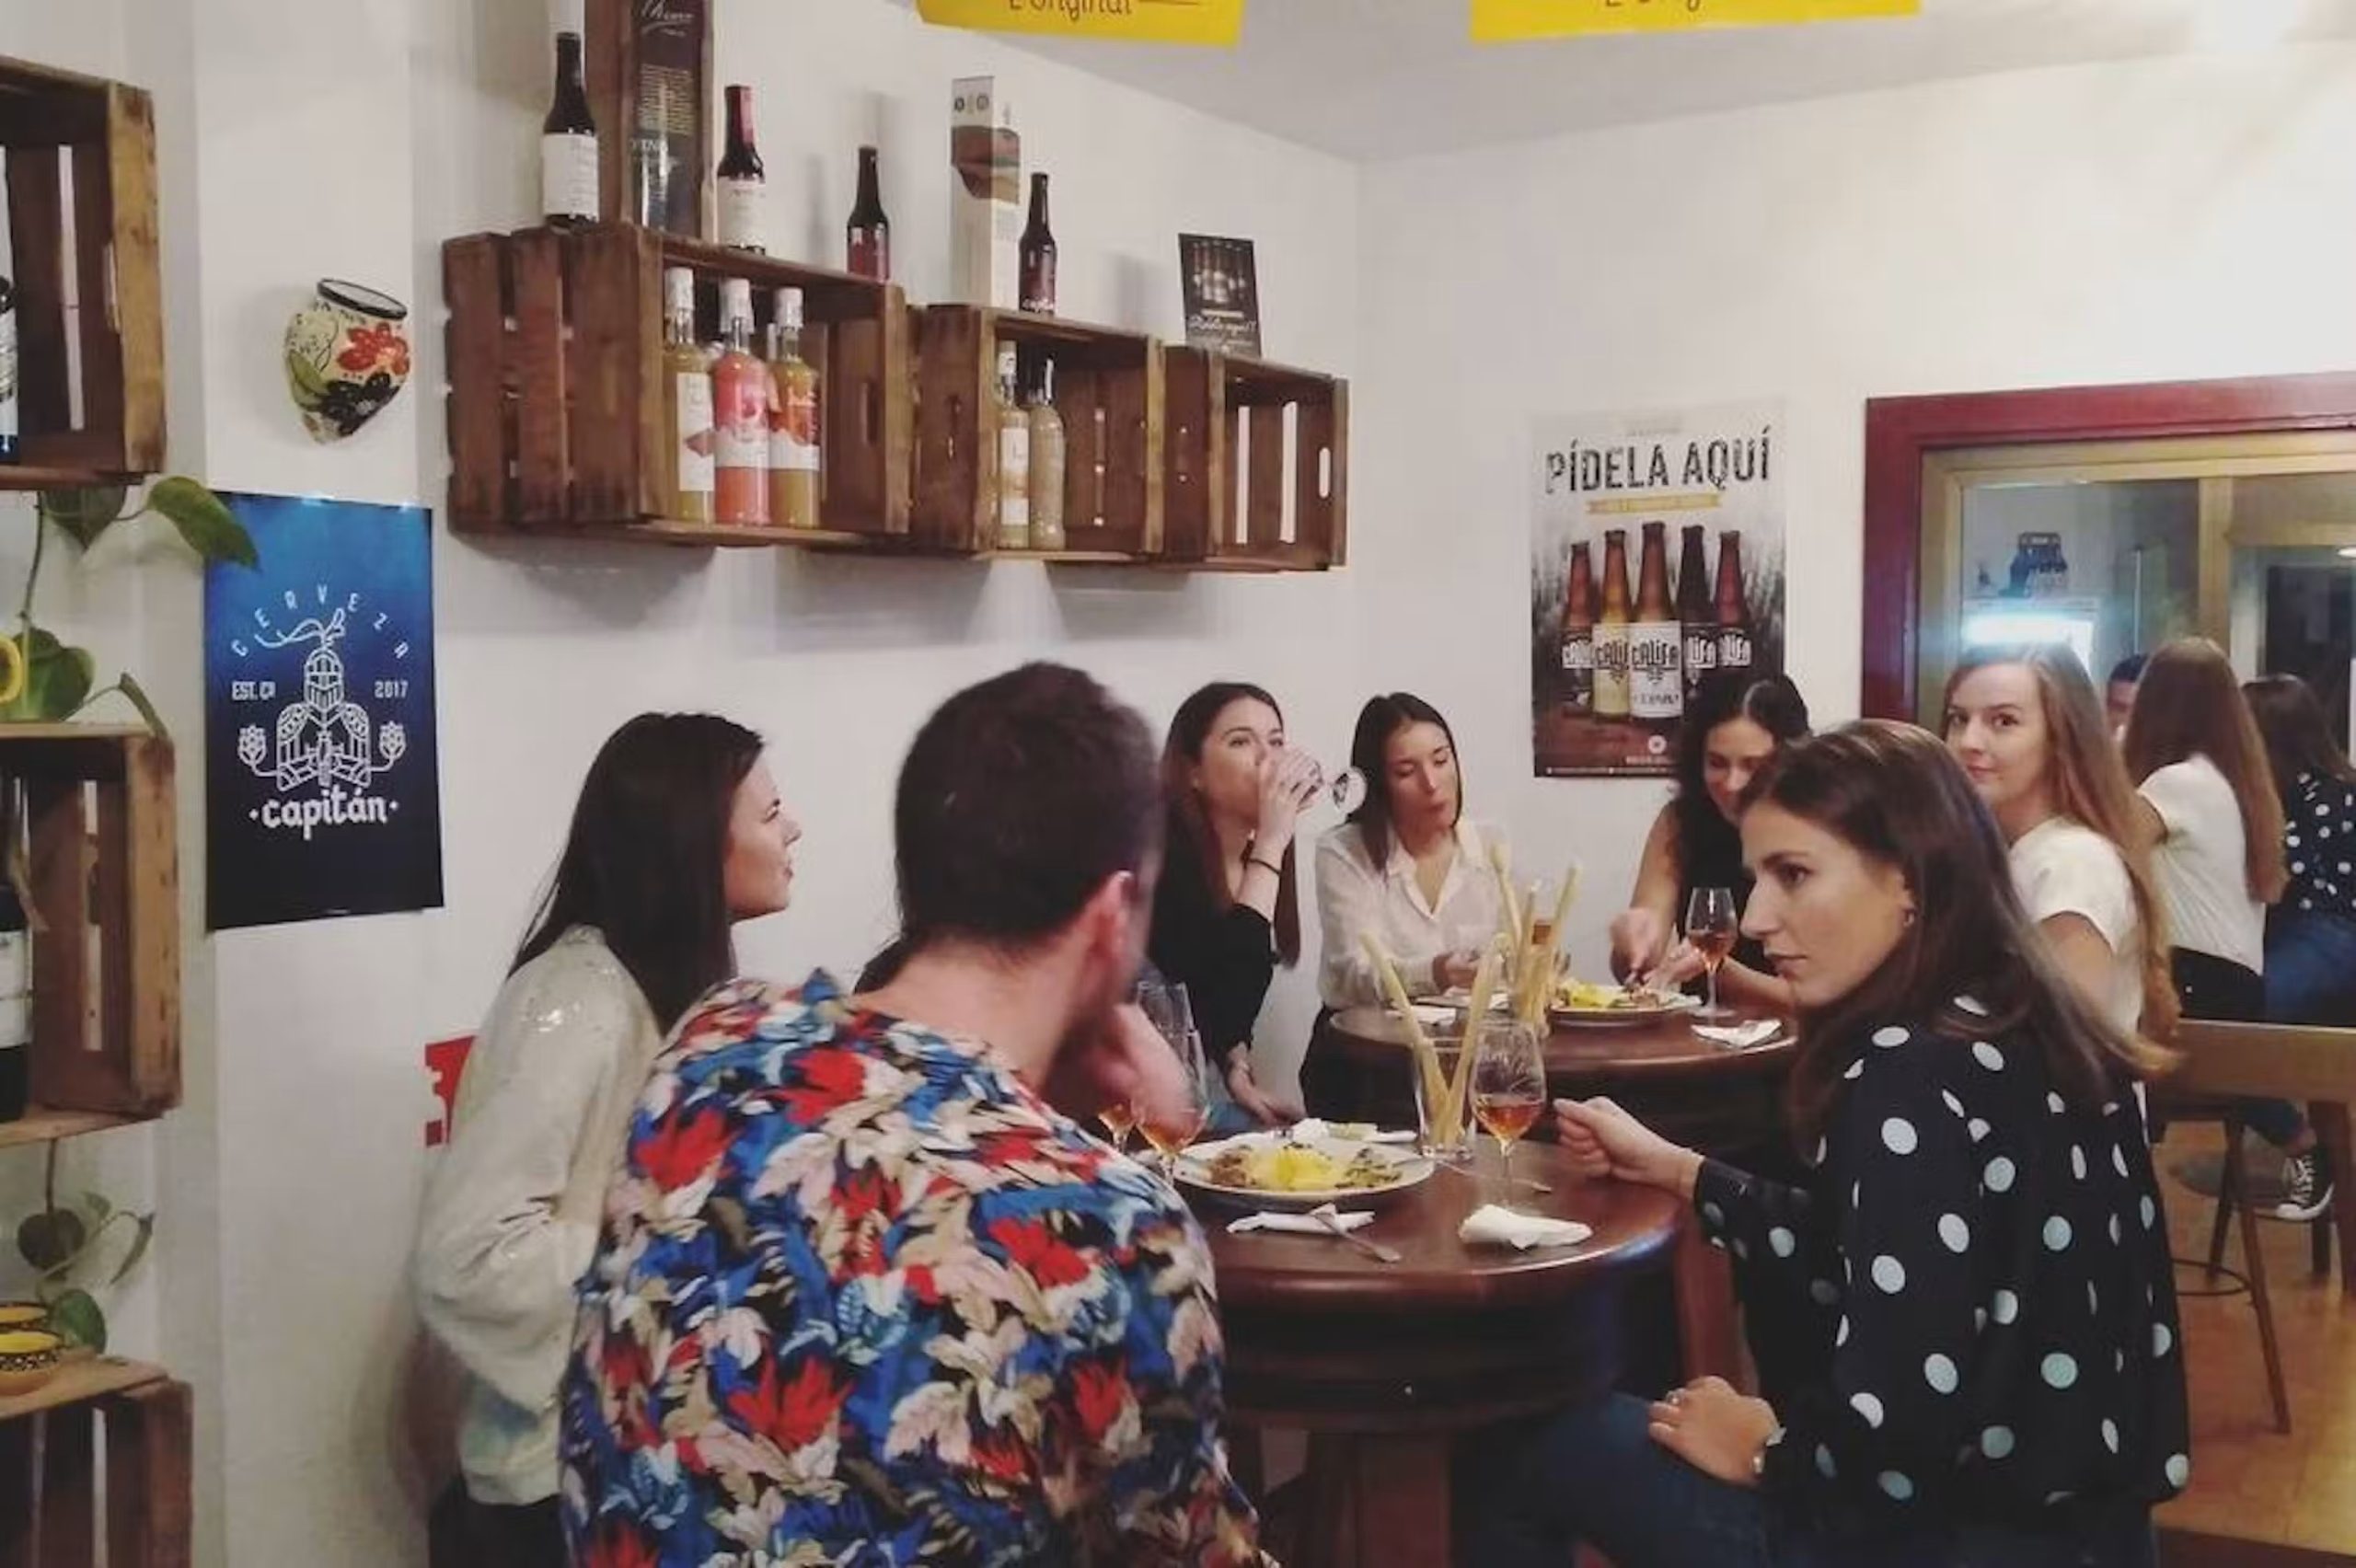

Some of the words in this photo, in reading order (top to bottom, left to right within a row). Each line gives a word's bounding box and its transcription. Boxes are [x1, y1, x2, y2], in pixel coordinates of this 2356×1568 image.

[1545, 438, 1669, 493] PÍDELA
[1682, 424, 1772, 491] AQUÍ
[231, 582, 409, 658] CERVEZA
[375, 679, 409, 699] 2017
[261, 784, 387, 841] capitán
